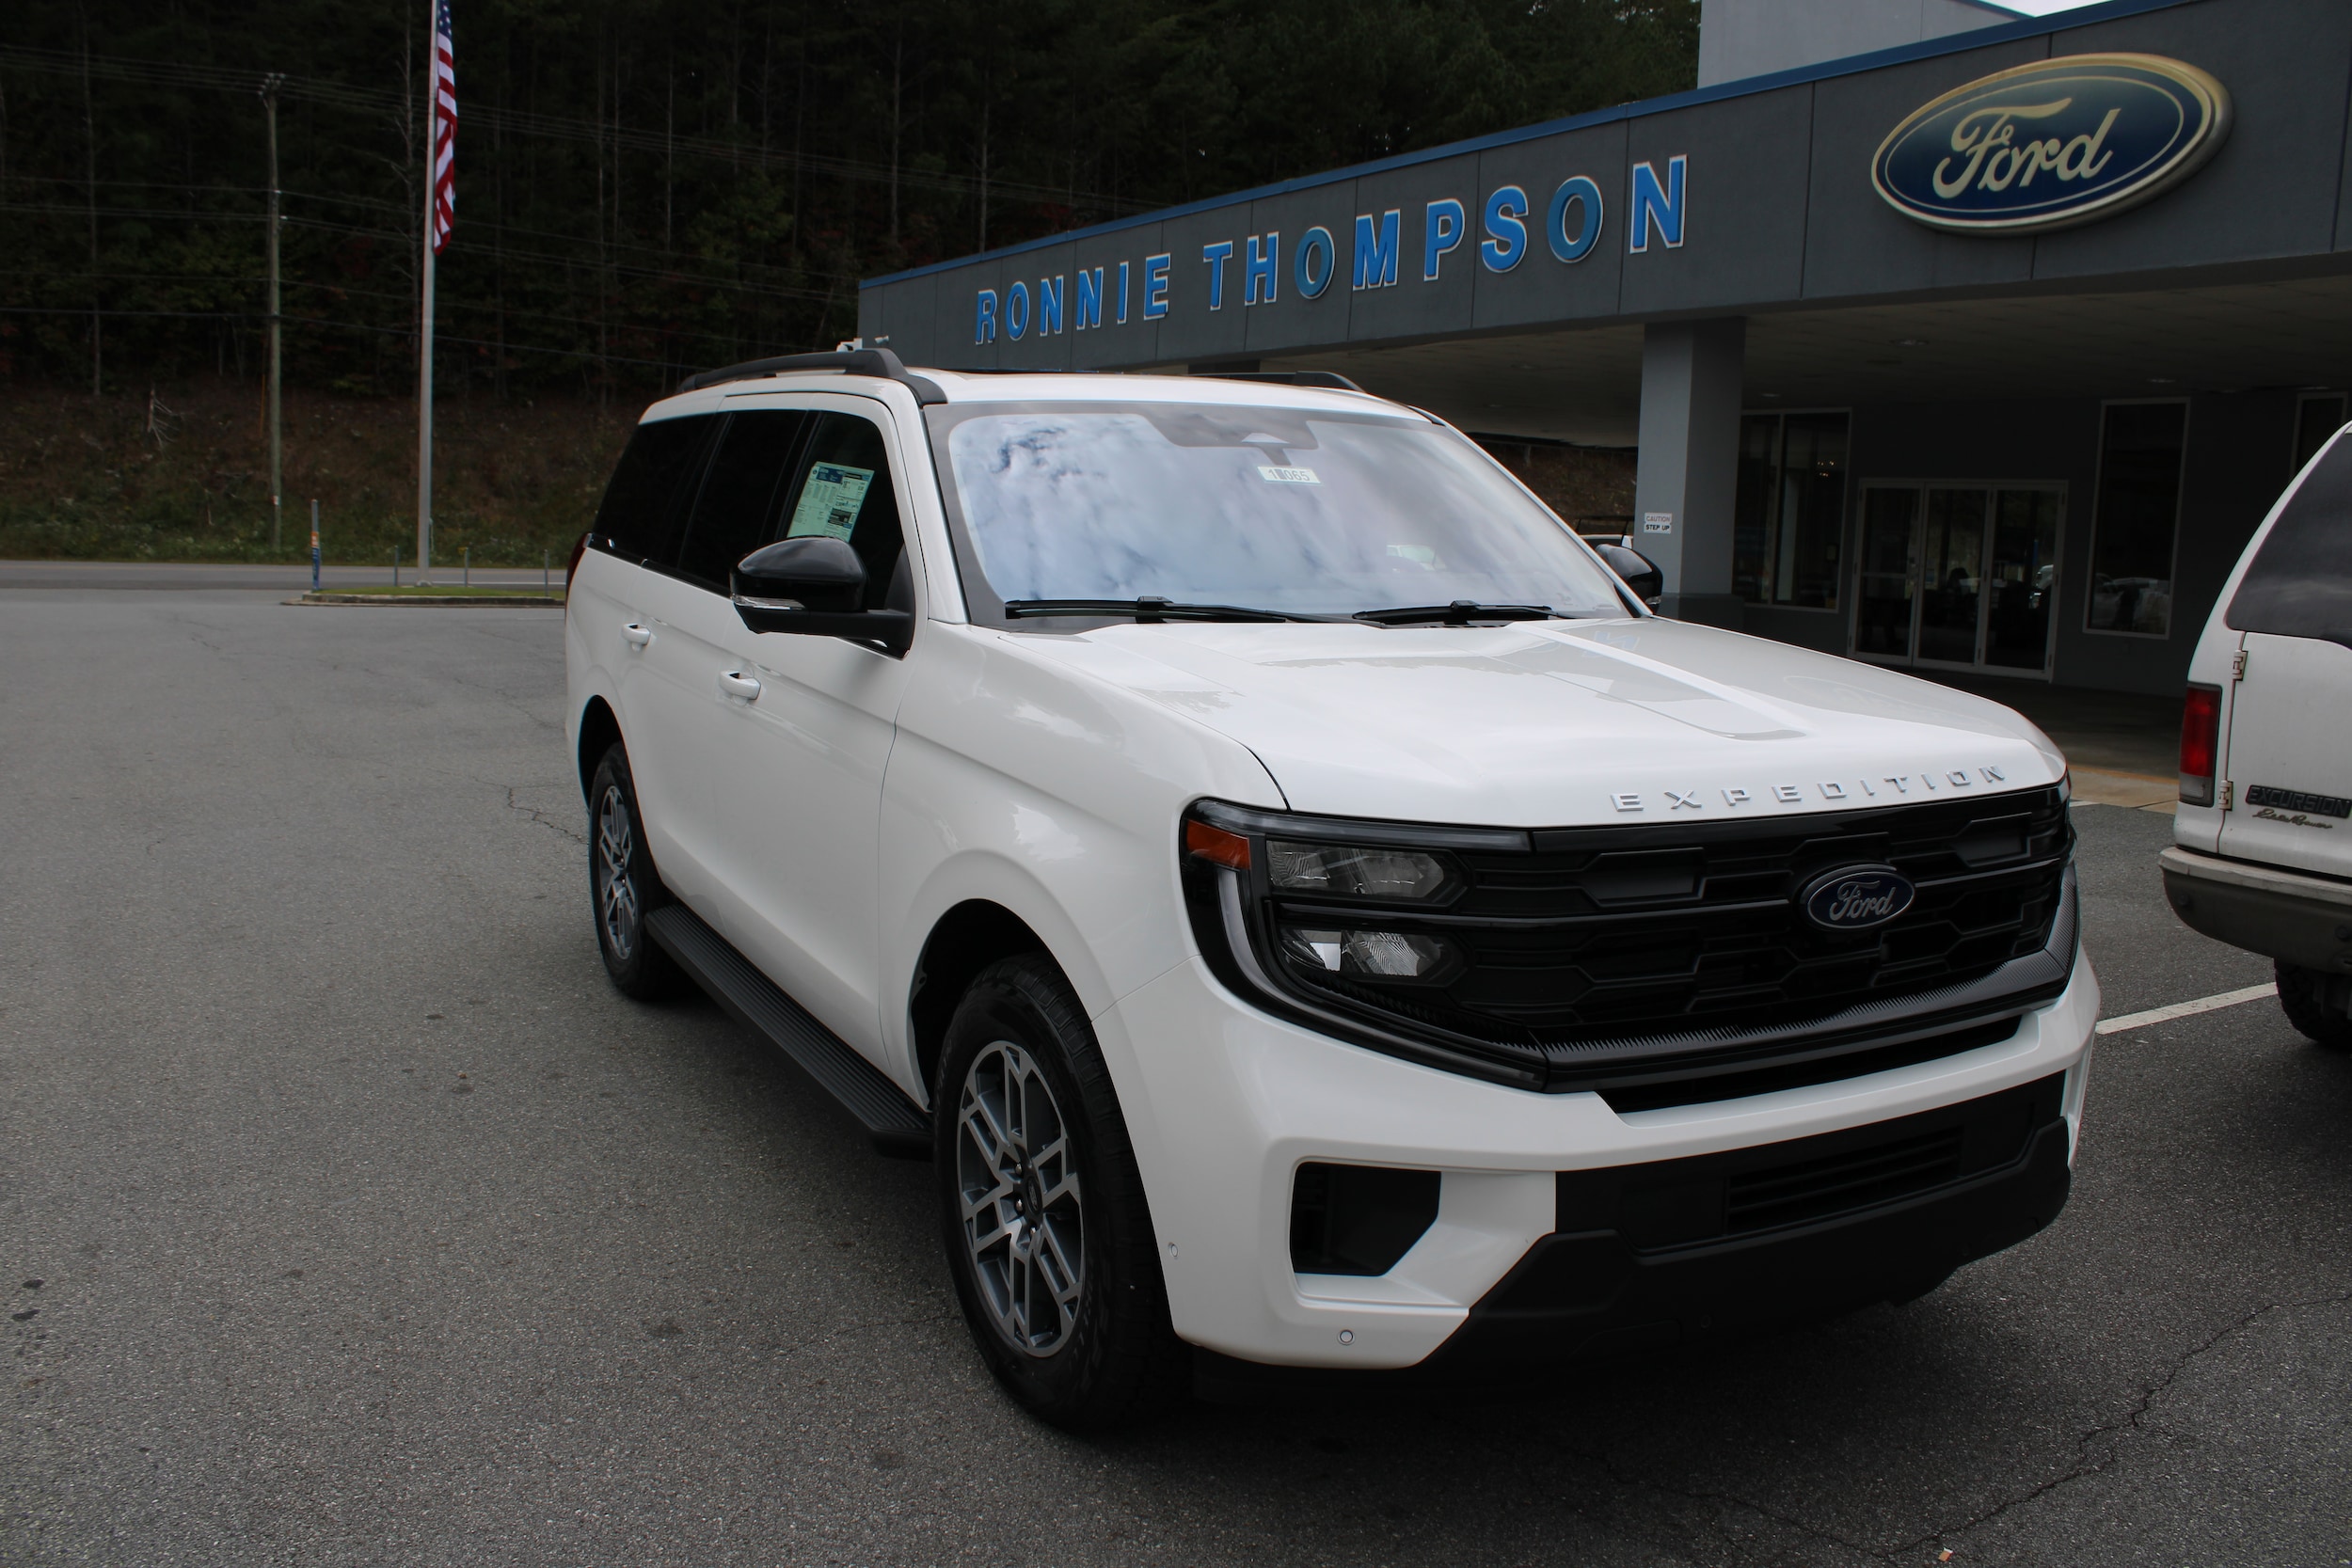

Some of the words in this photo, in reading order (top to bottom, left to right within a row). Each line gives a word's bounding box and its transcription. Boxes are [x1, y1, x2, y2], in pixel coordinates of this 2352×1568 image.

[1932, 97, 2122, 199] Ford
[976, 252, 1171, 346] RONNIE
[1203, 154, 1688, 311] THOMPSON
[1268, 468, 1311, 482] 1065
[1610, 764, 2007, 813] EXPEDITION
[2247, 786, 2352, 818] EXCURSION
[1829, 879, 1897, 921] Ford
